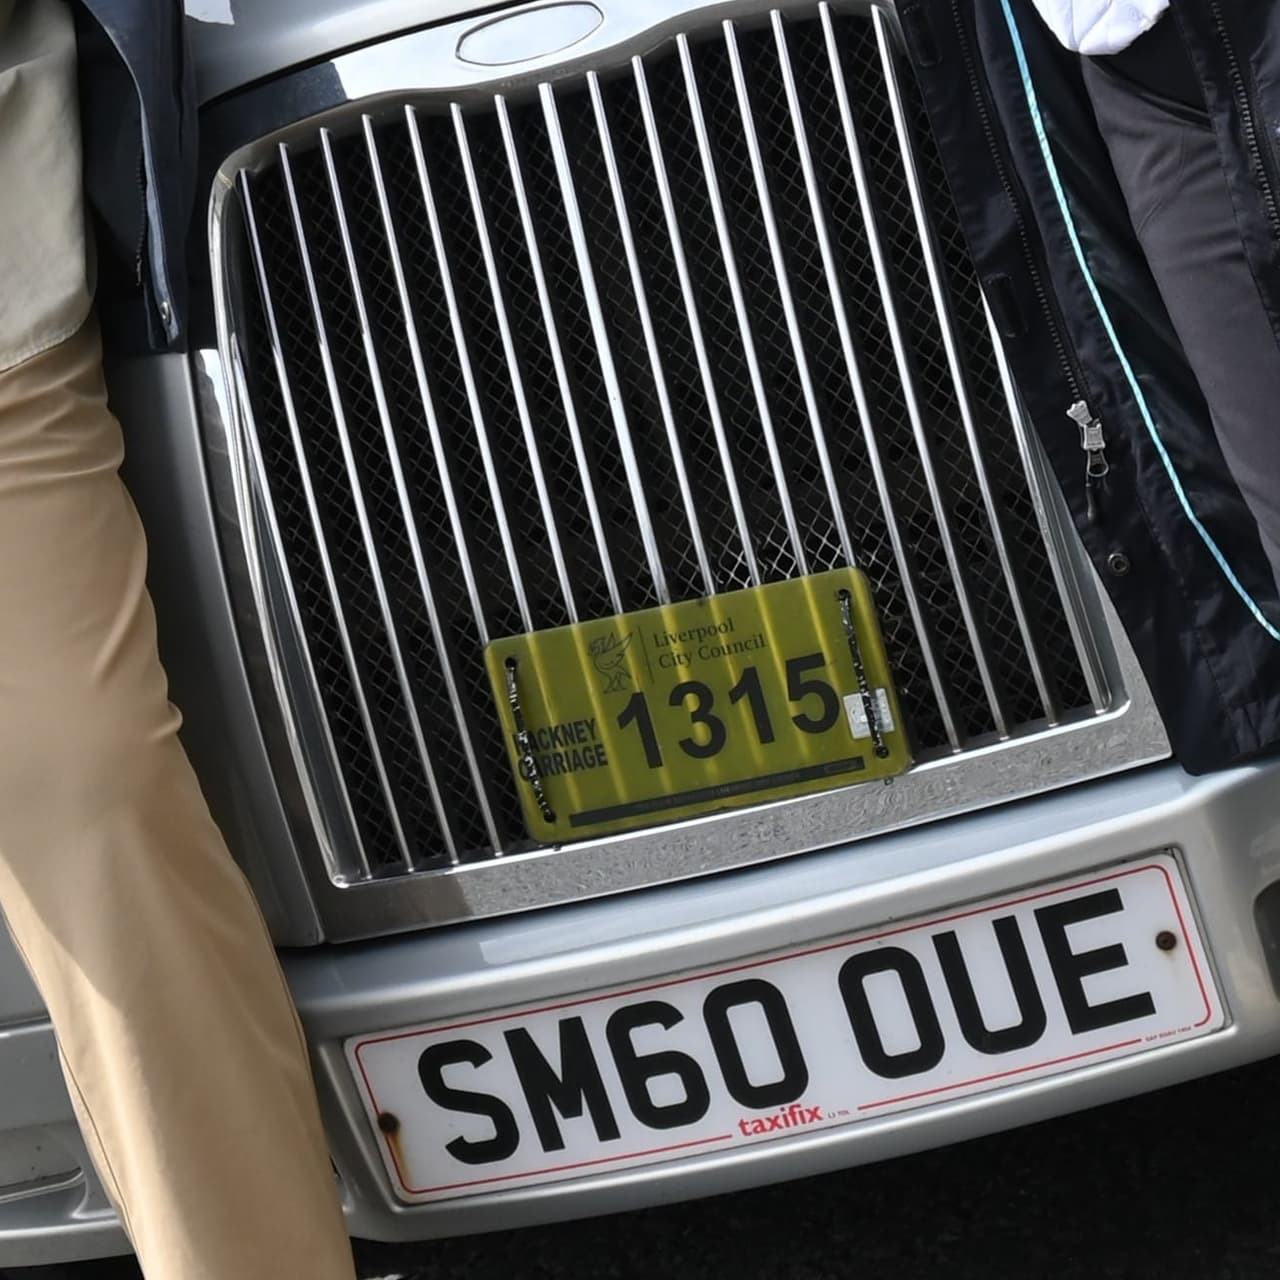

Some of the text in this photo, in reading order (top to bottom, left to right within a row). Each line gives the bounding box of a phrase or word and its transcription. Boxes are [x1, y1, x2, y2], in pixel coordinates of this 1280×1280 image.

[653, 617, 736, 648] Liverpool
[658, 633, 766, 669] City Council
[617, 652, 840, 769] 1315
[417, 887, 1157, 1166] SM60 OUE
[738, 1104, 824, 1136] taxifix
